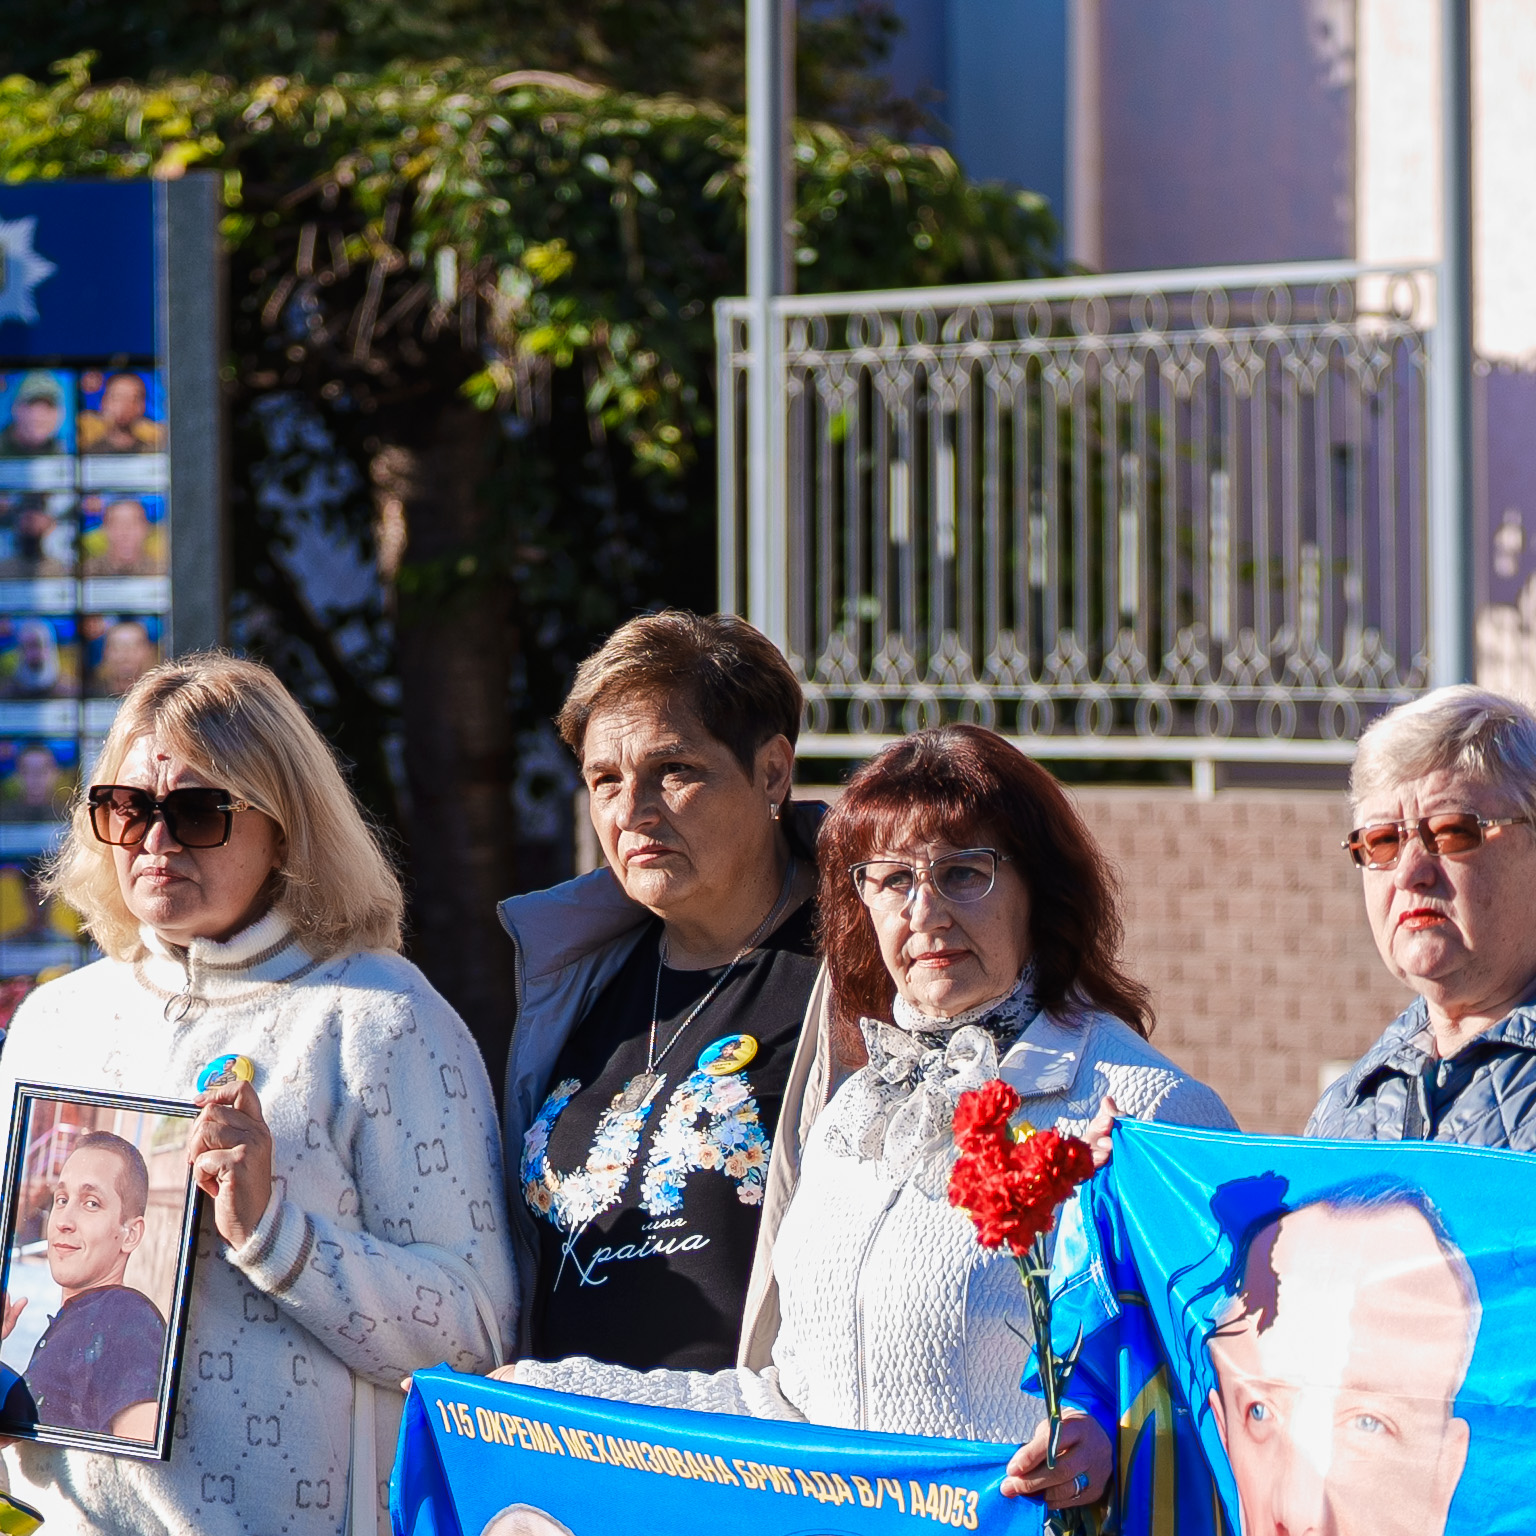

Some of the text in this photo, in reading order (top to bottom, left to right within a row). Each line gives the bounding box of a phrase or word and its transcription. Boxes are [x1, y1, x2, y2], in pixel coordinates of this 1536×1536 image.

[553, 1220, 711, 1293] Країна
[640, 1216, 688, 1232] моя
[435, 1398, 980, 1531] 115 ОКРЕМА МЕХАНІЗОВАНА БРИГАДА В/Ч А4053
